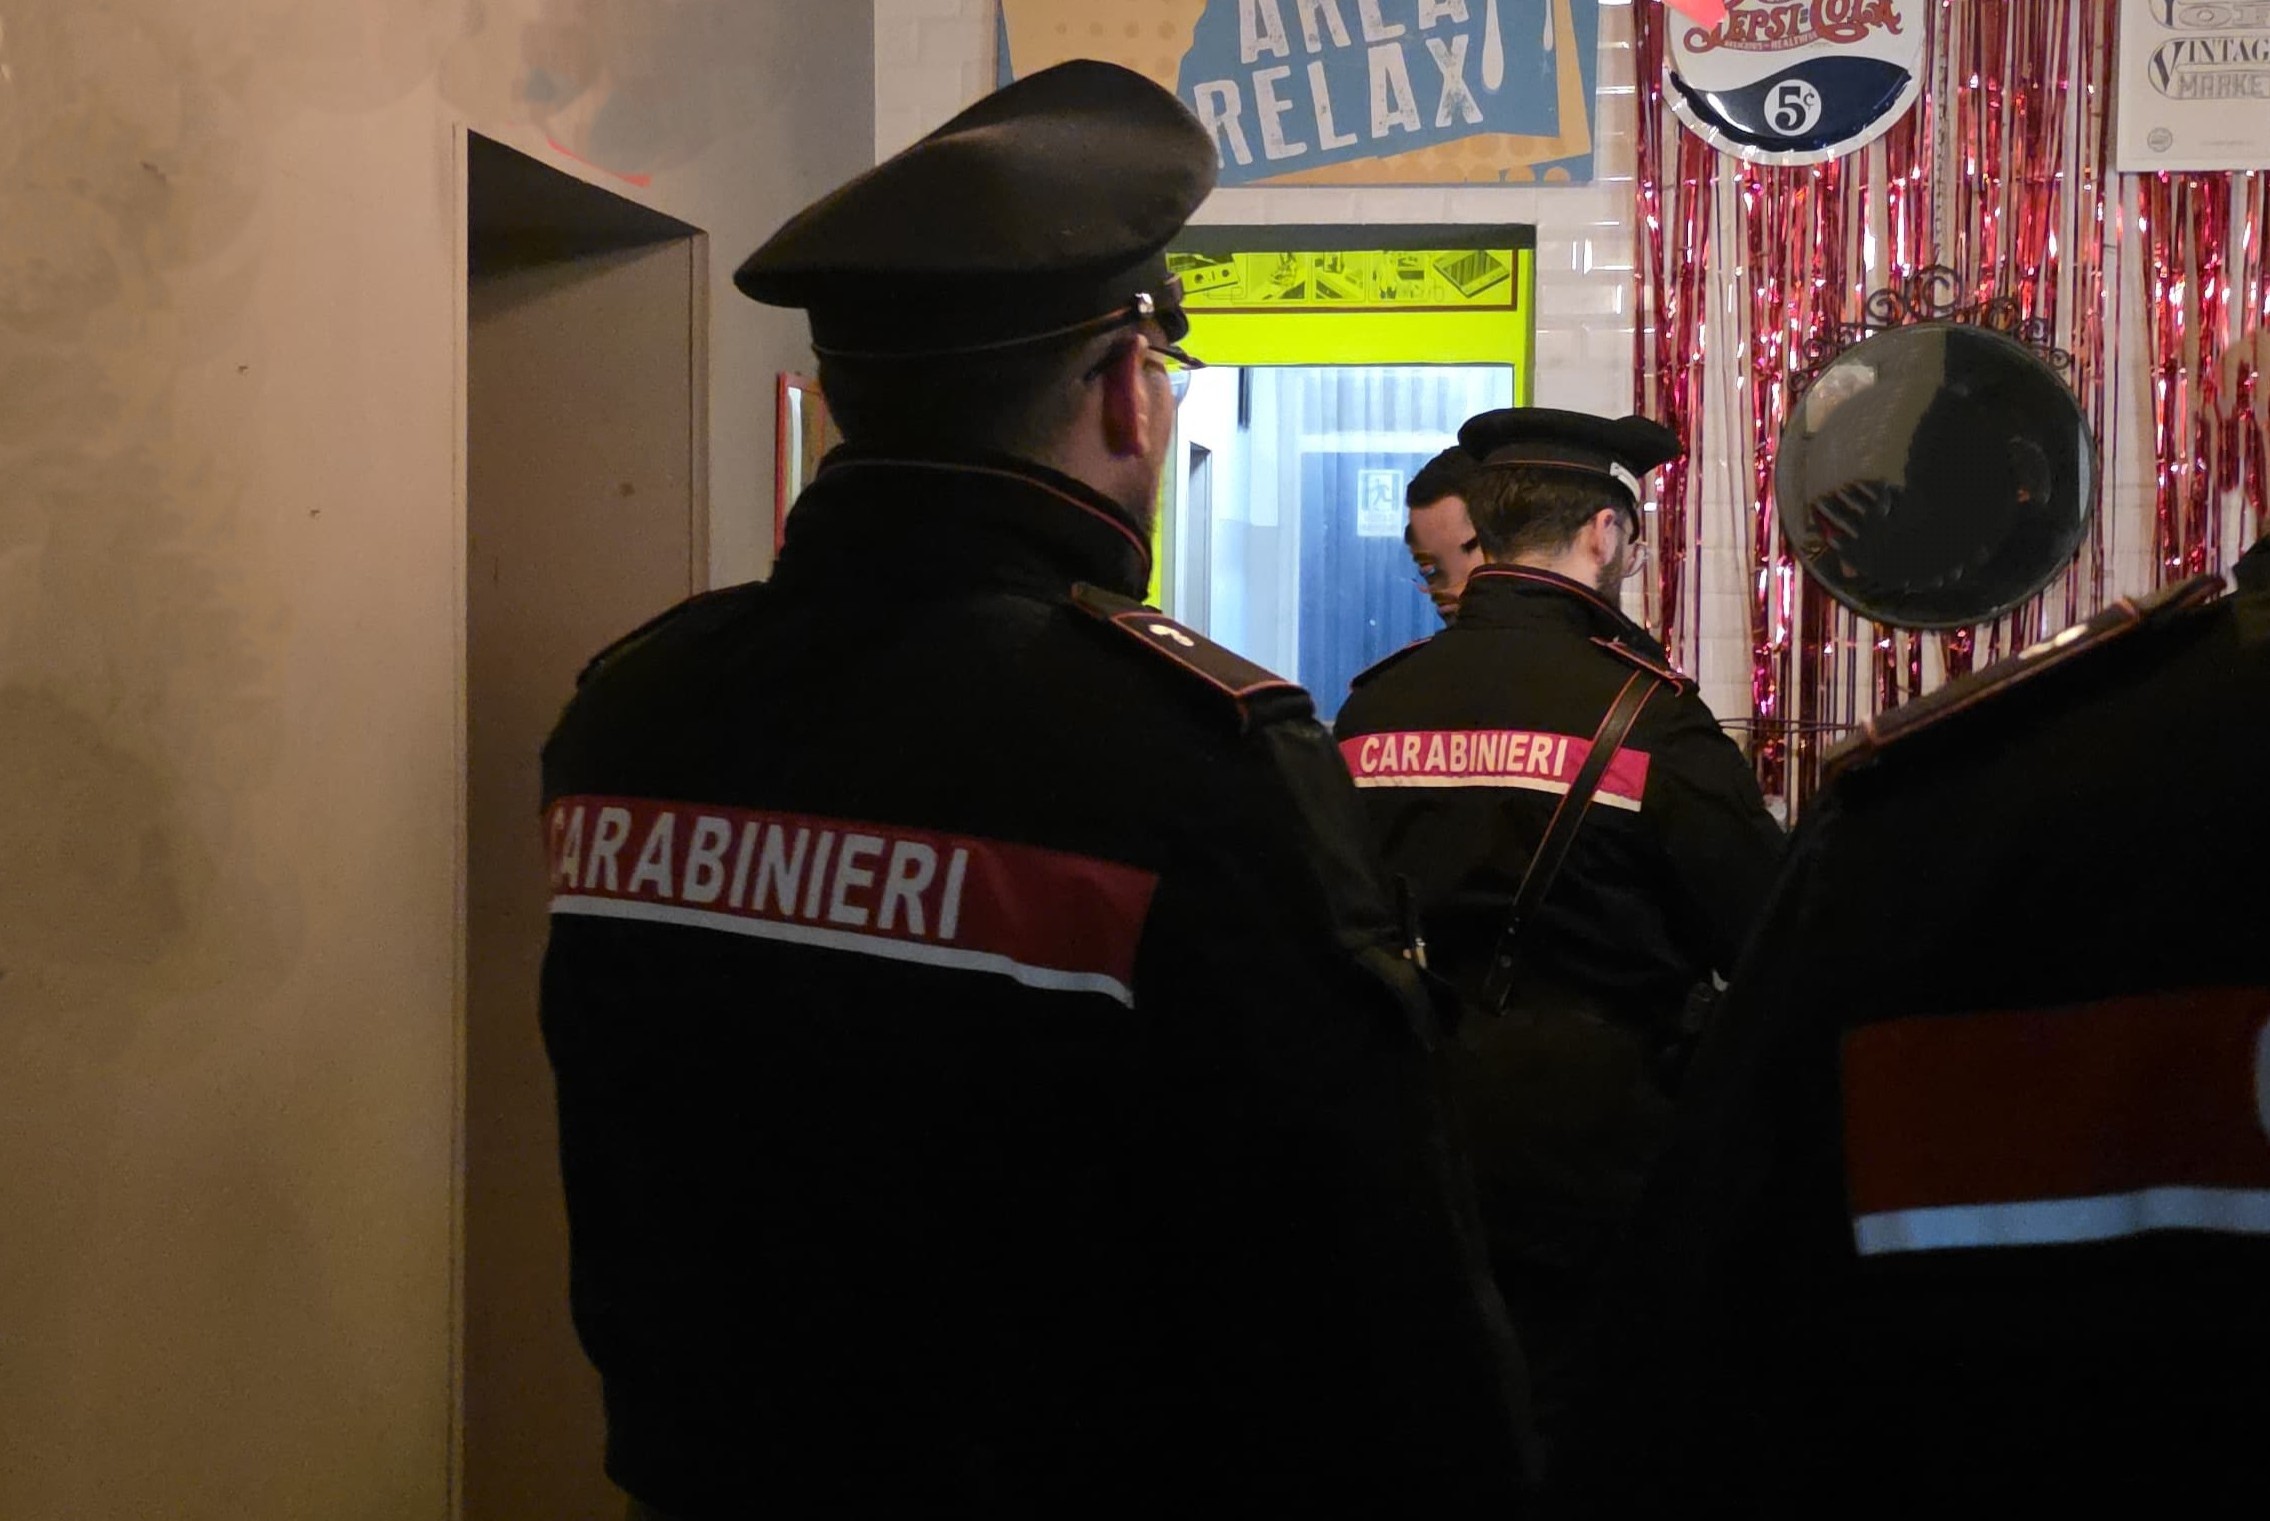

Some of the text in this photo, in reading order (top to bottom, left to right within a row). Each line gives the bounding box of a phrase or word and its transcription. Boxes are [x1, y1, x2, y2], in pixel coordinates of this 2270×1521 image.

[1239, 0, 1470, 64] AR
[1193, 34, 1484, 169] RELAX
[1359, 734, 1568, 776] CARABINIERI
